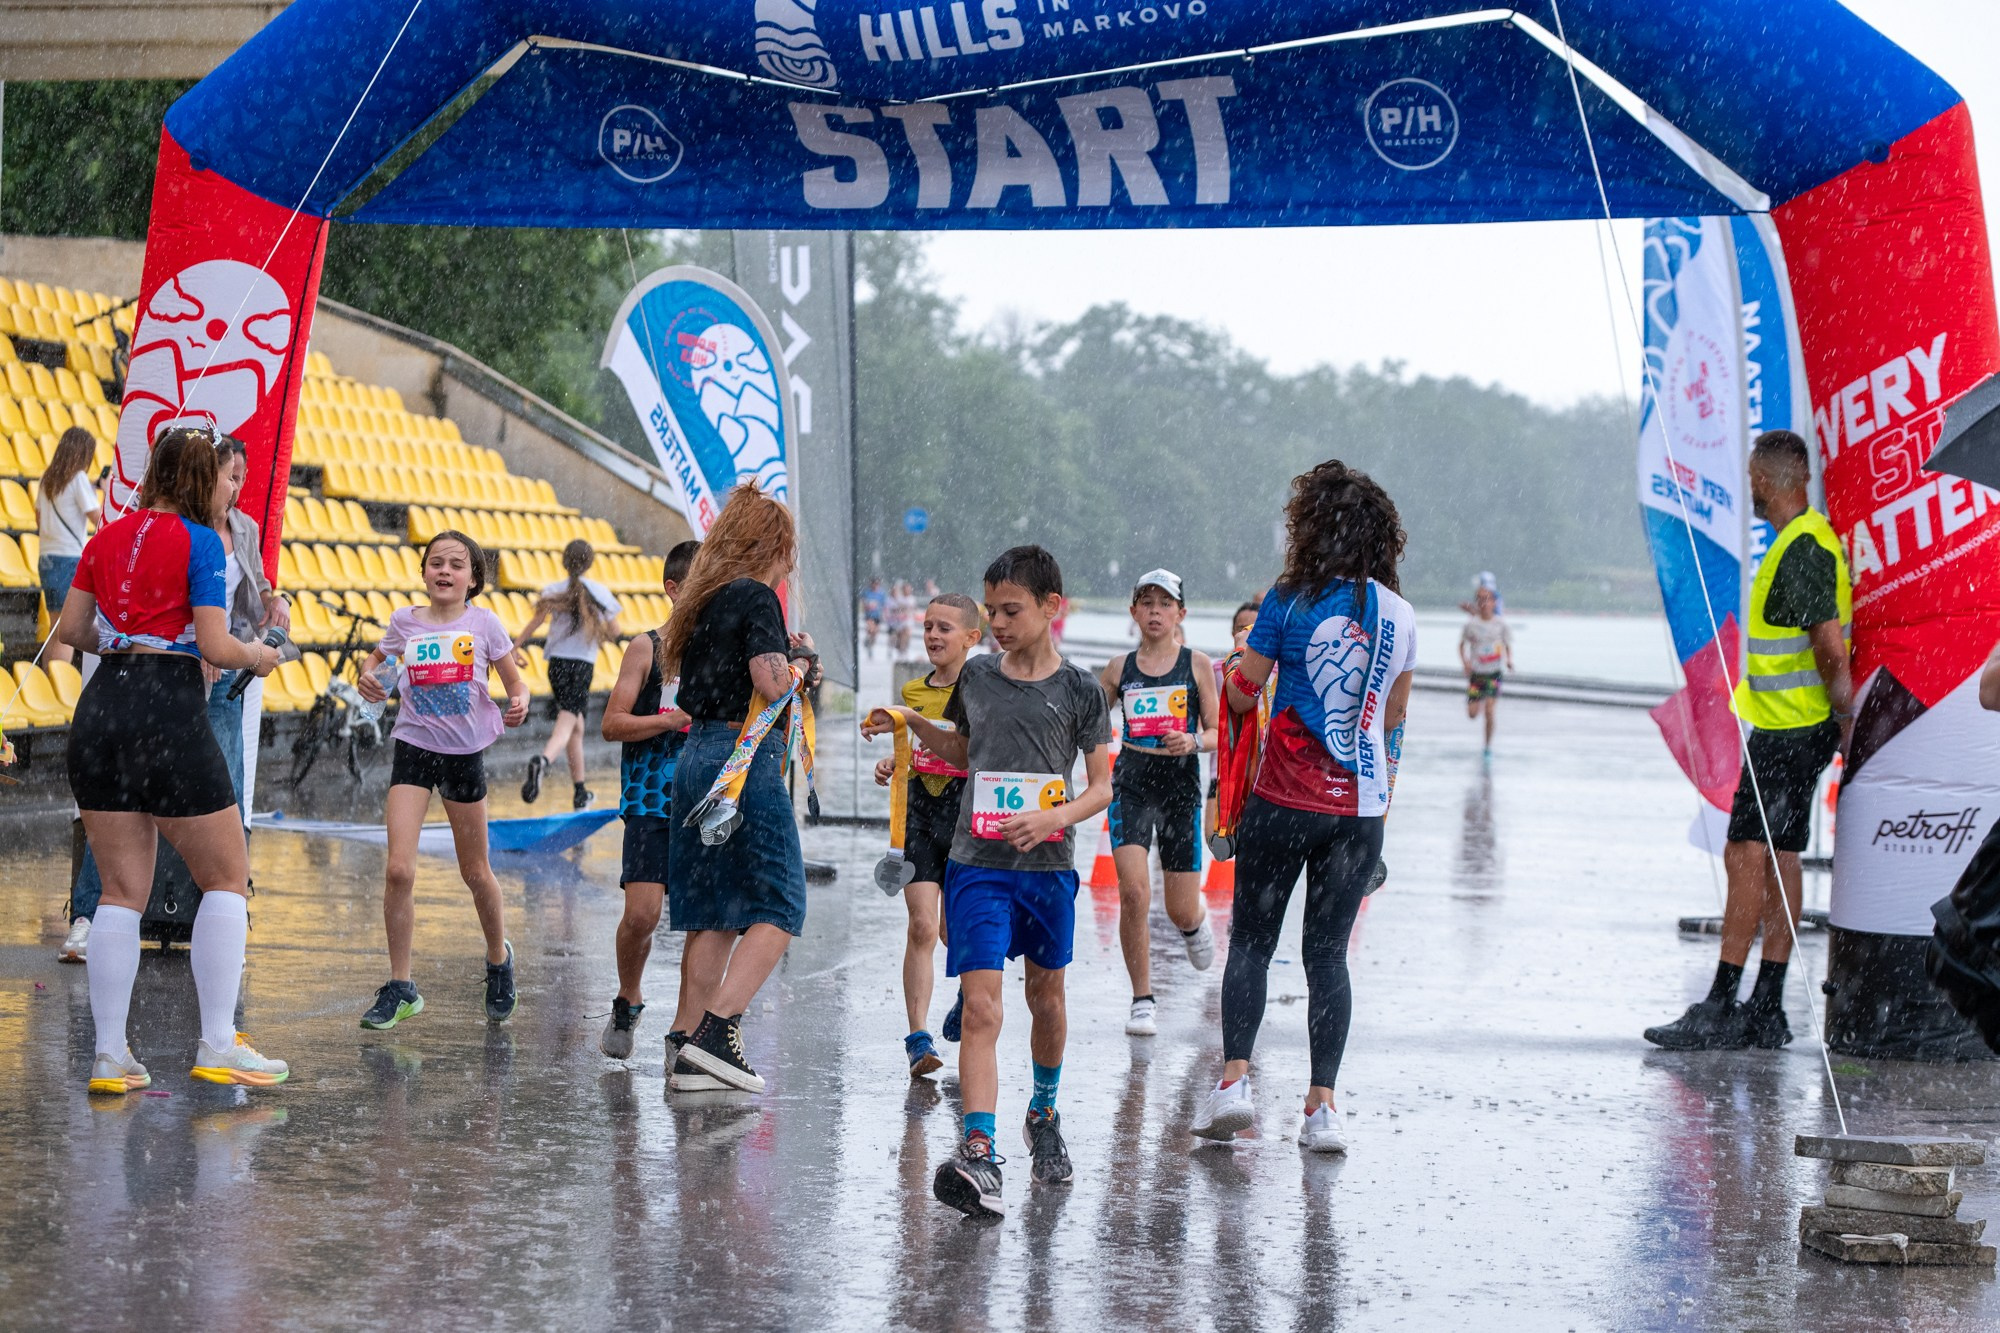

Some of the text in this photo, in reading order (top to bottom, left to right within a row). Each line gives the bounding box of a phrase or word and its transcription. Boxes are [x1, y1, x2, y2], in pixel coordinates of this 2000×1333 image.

[1037, 0, 1070, 14] IN
[1043, 0, 1207, 38] MARKOVO
[859, 0, 1025, 62] HILLS
[1380, 105, 1442, 136] P/H
[613, 128, 667, 155] P/H
[788, 76, 1237, 209] START
[1384, 137, 1443, 146] MARKOVO
[1816, 332, 1947, 472] VERY
[417, 643, 441, 662] 50
[1133, 696, 1158, 715] 62
[1358, 617, 1396, 780] EVERY STEP MATTERS
[994, 786, 1024, 810] 16
